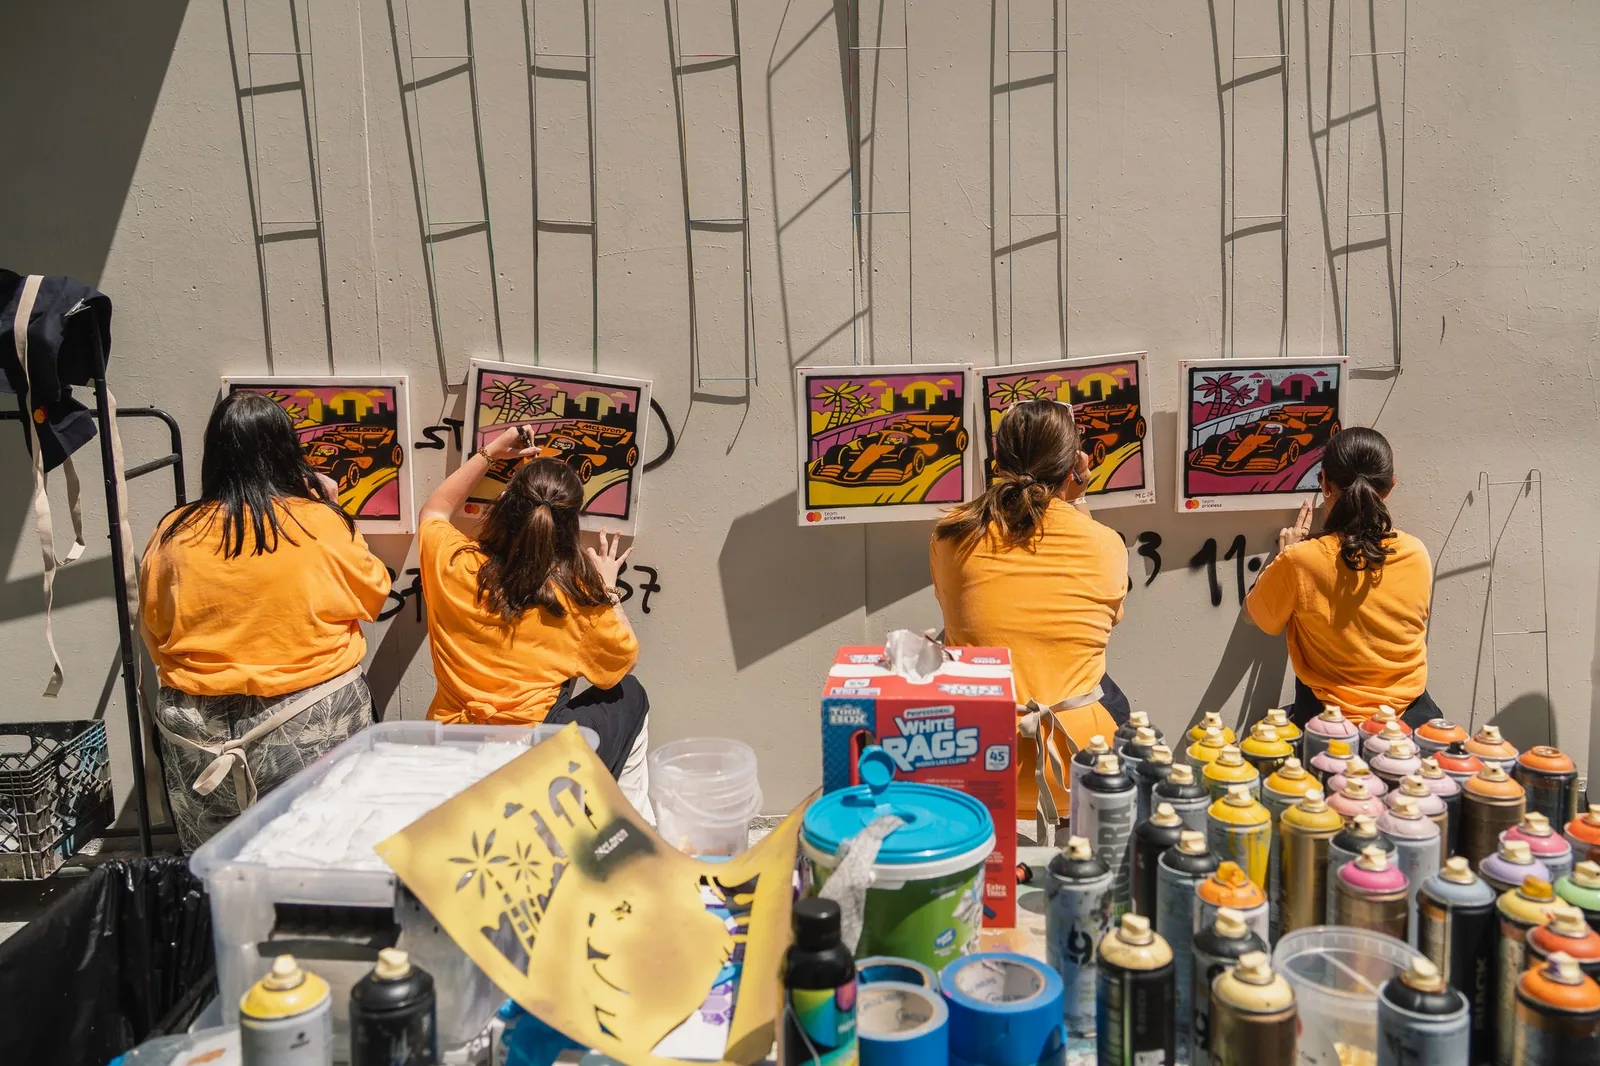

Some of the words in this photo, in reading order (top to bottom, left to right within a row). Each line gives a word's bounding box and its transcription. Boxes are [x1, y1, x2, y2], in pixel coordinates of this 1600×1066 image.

[582, 424, 621, 434] McLaren
[829, 707, 863, 716] TOOL
[830, 715, 867, 726] BOX
[895, 717, 954, 737] WHITE
[882, 728, 978, 772] RAGS
[989, 751, 1004, 761] 45
